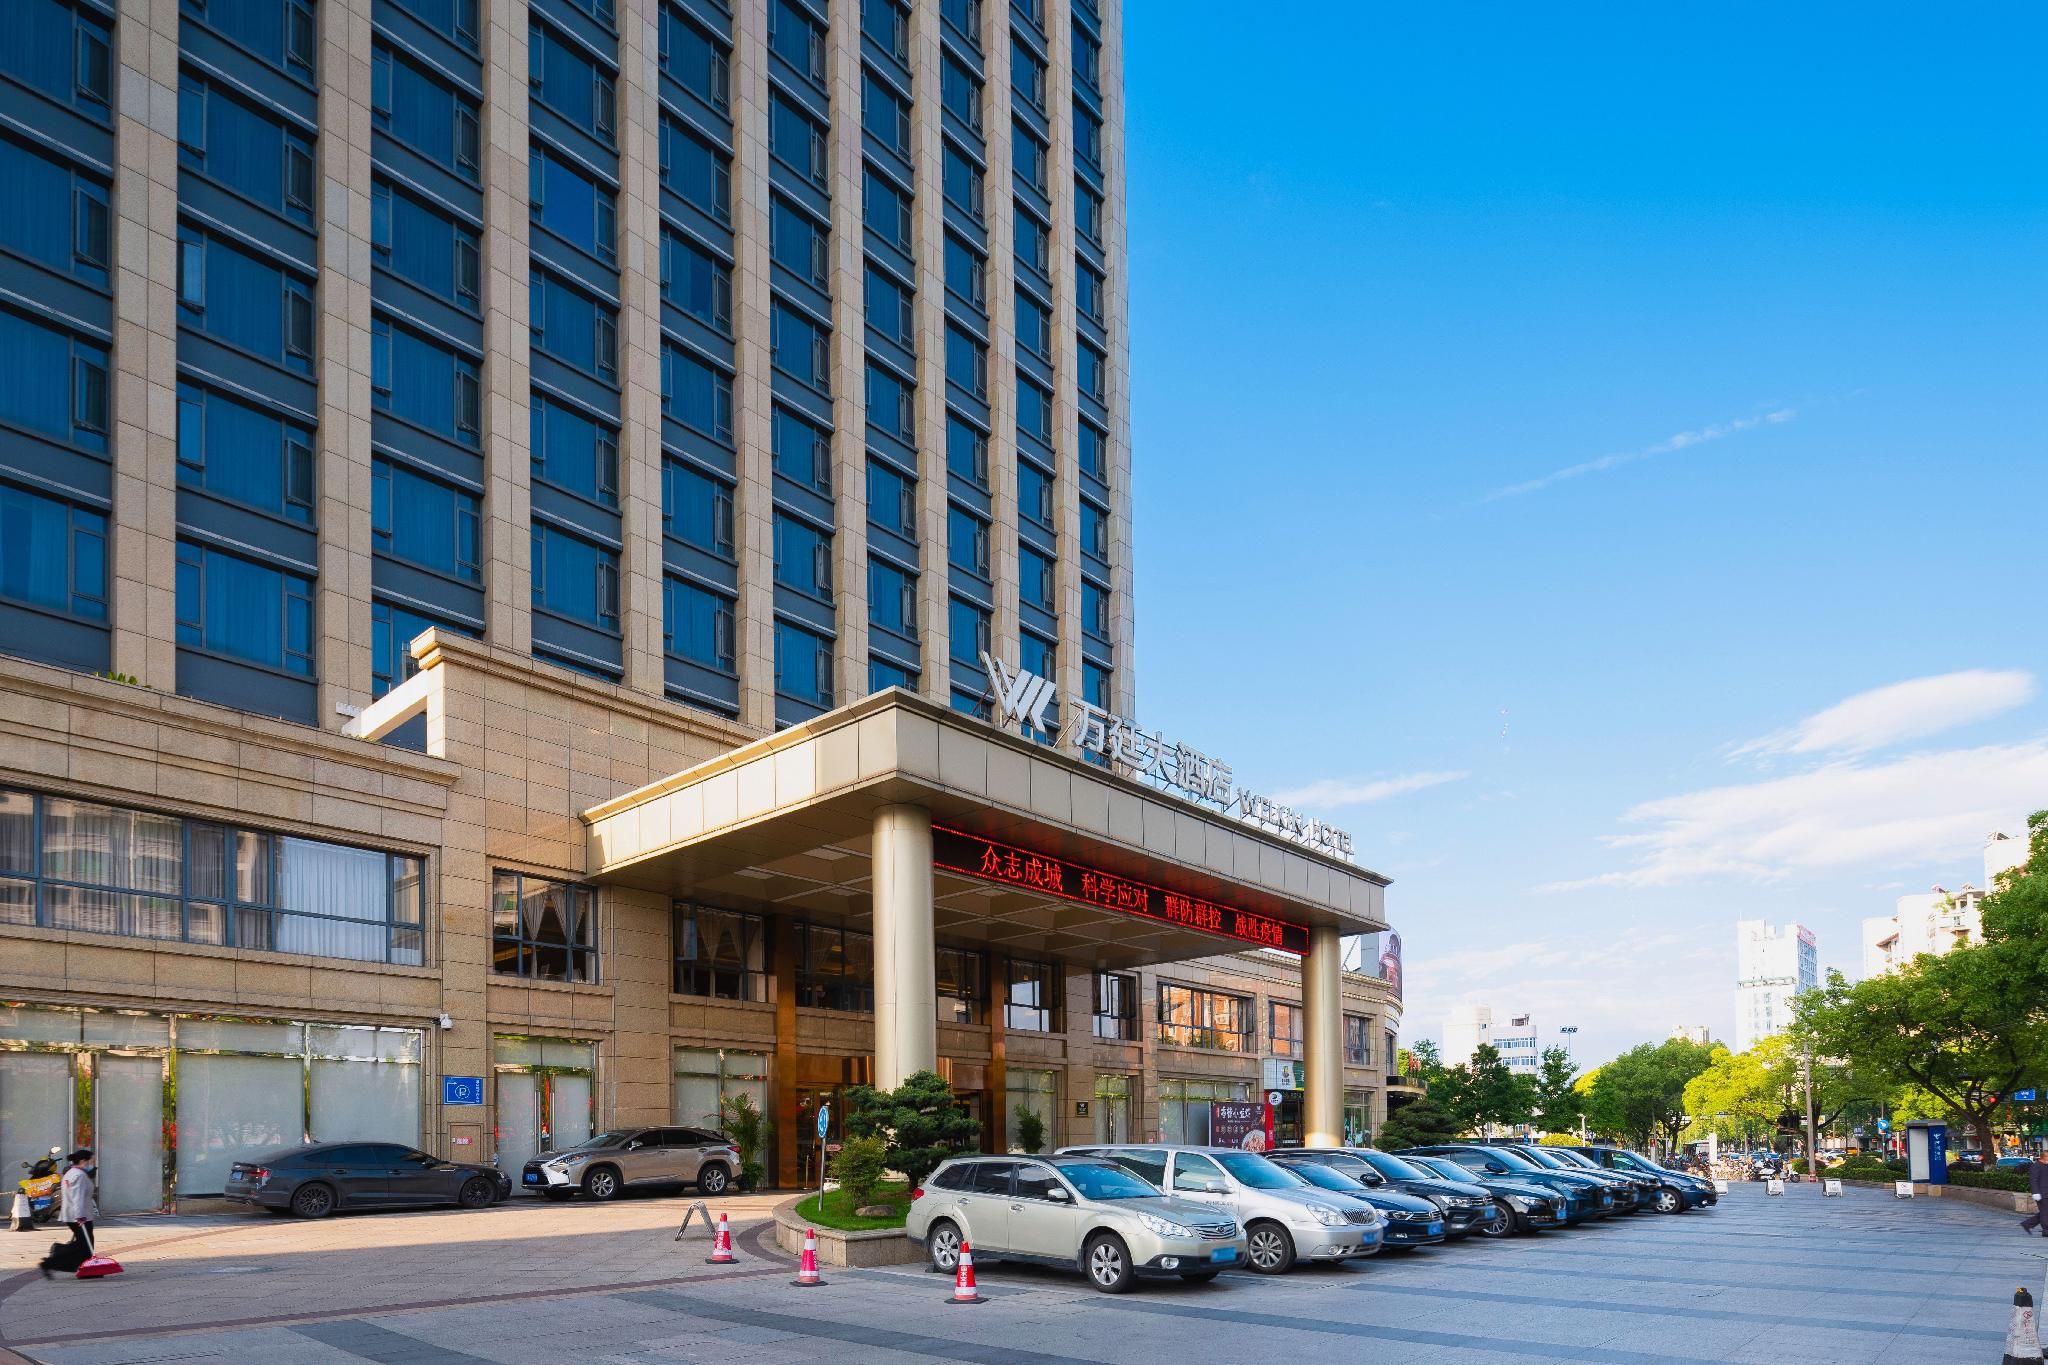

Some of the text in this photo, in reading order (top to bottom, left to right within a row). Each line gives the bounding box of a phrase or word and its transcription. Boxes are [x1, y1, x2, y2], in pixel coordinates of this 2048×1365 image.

[1069, 697, 1233, 808] 万廷大酒店
[980, 845, 1283, 946] 众志成城 科学应对 群防群控 战胜疫情
